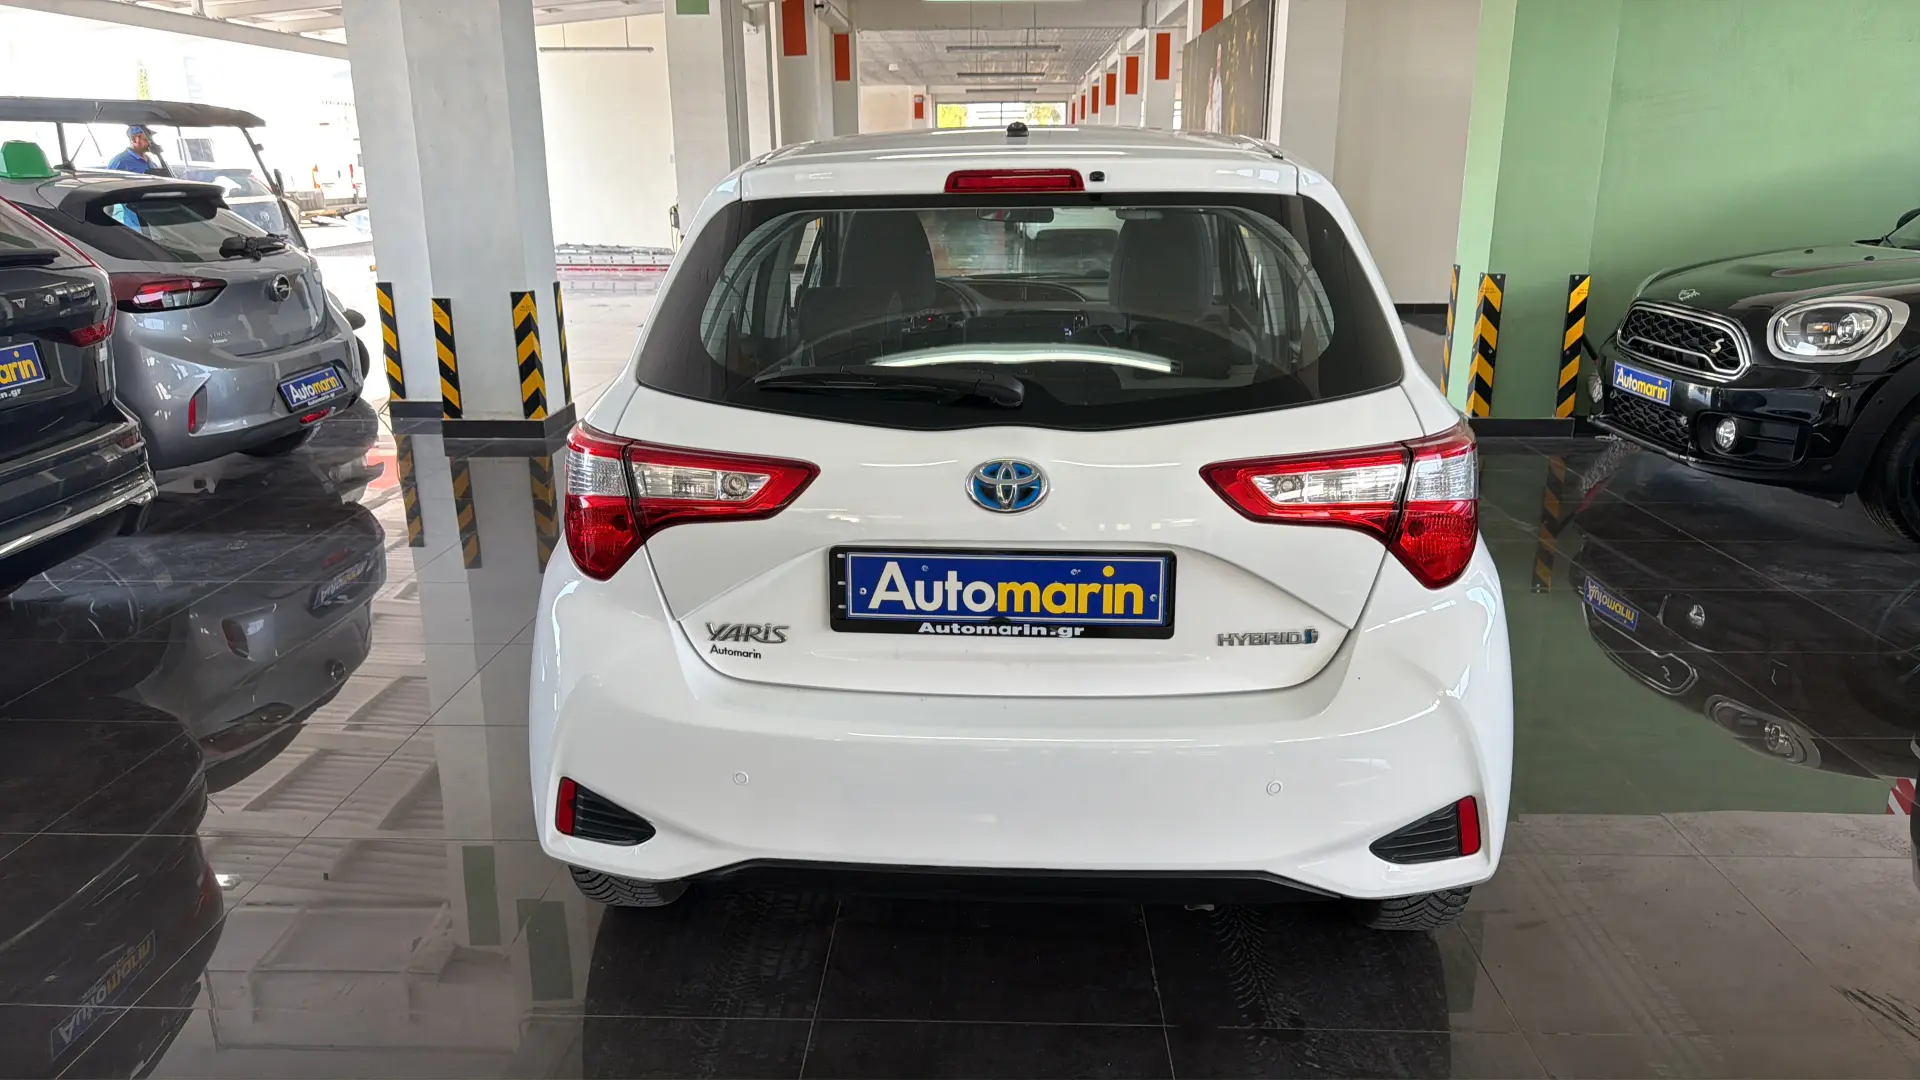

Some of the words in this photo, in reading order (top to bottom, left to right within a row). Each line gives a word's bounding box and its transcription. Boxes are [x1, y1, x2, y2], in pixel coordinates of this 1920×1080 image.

[289, 372, 340, 403] Automarin
[1616, 367, 1667, 401] Automarin
[867, 561, 1144, 614] Automarin
[918, 621, 1084, 638] Automarin.gr
[1217, 632, 1302, 646] HYBRID
[710, 644, 762, 660] Automarin
